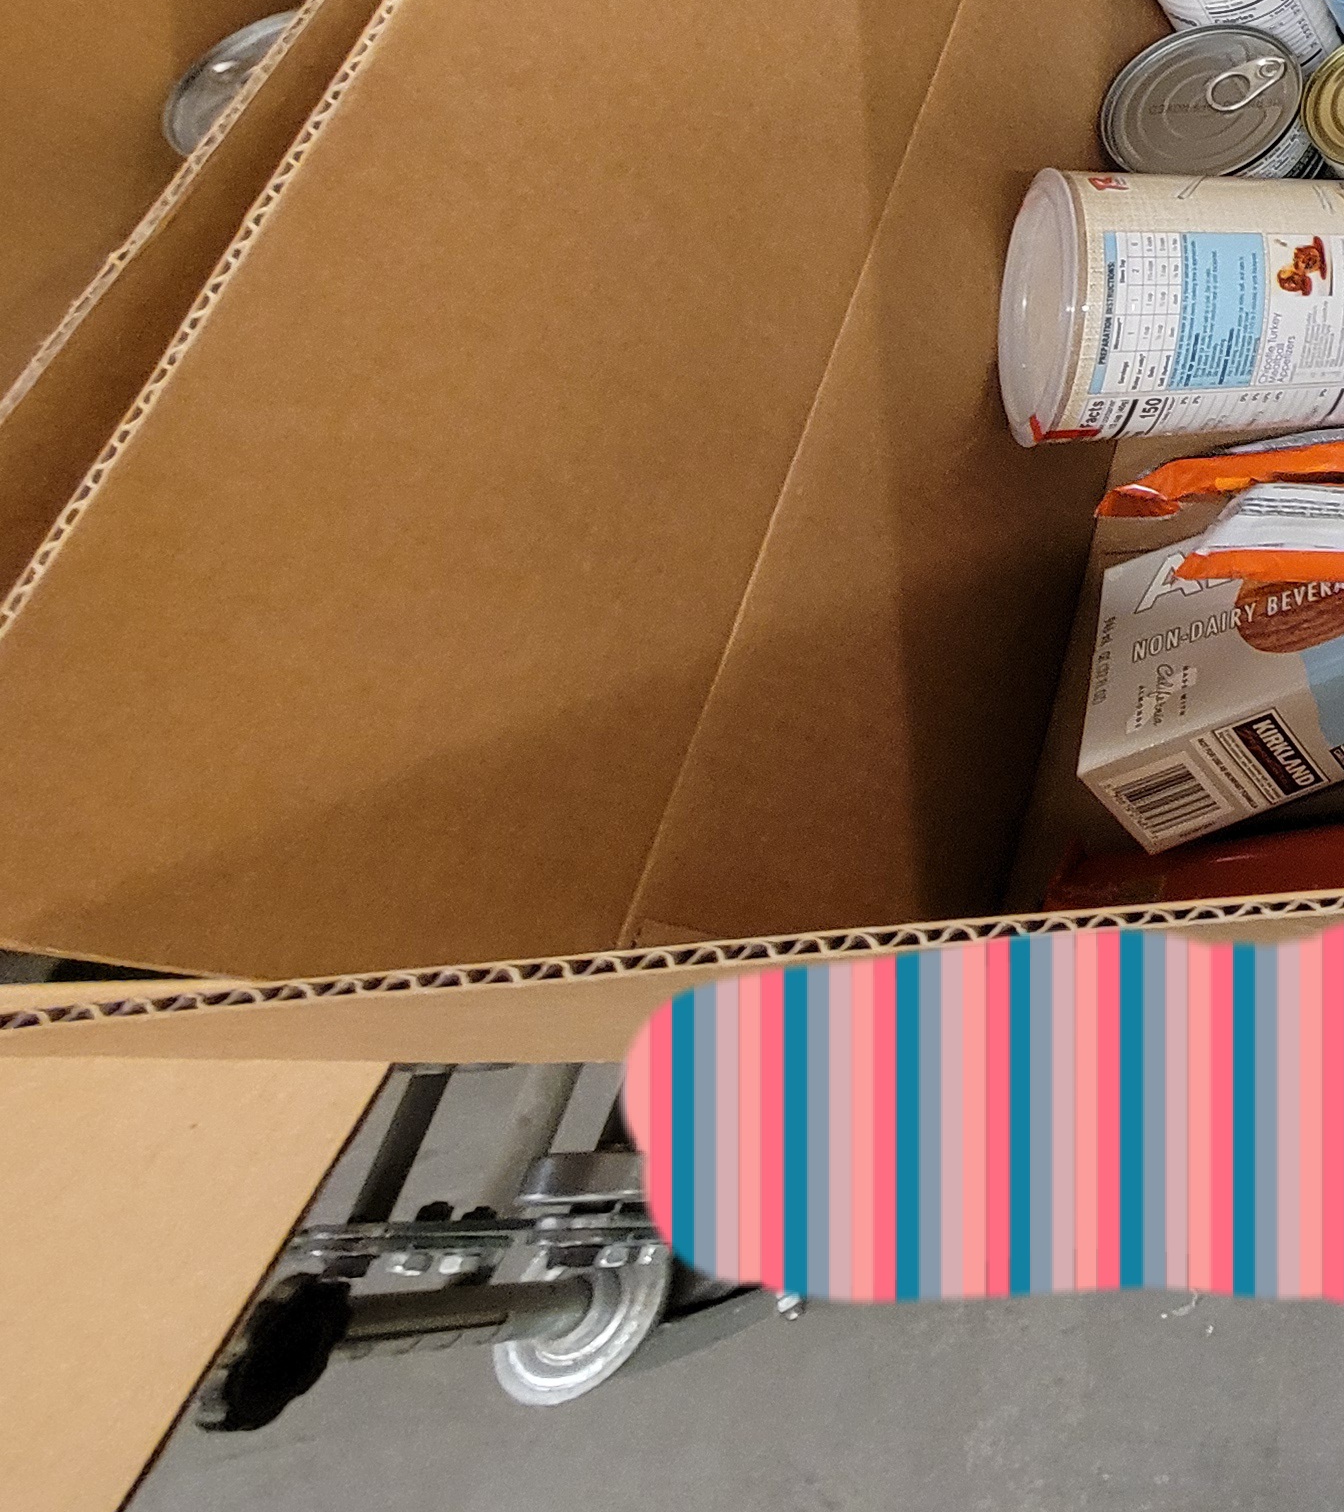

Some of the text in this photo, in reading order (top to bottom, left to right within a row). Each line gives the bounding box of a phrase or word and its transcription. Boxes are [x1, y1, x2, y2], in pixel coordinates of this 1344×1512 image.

[1100, 262, 1116, 365] PREPARATION INSTRUCTIONS:
[1269, 312, 1282, 344] Turkey
[1278, 336, 1296, 383] Appetizers
[1139, 397, 1162, 420] 150
[1131, 602, 1257, 663] NON-DAIRY
[1251, 718, 1316, 790] KIRKLAND
